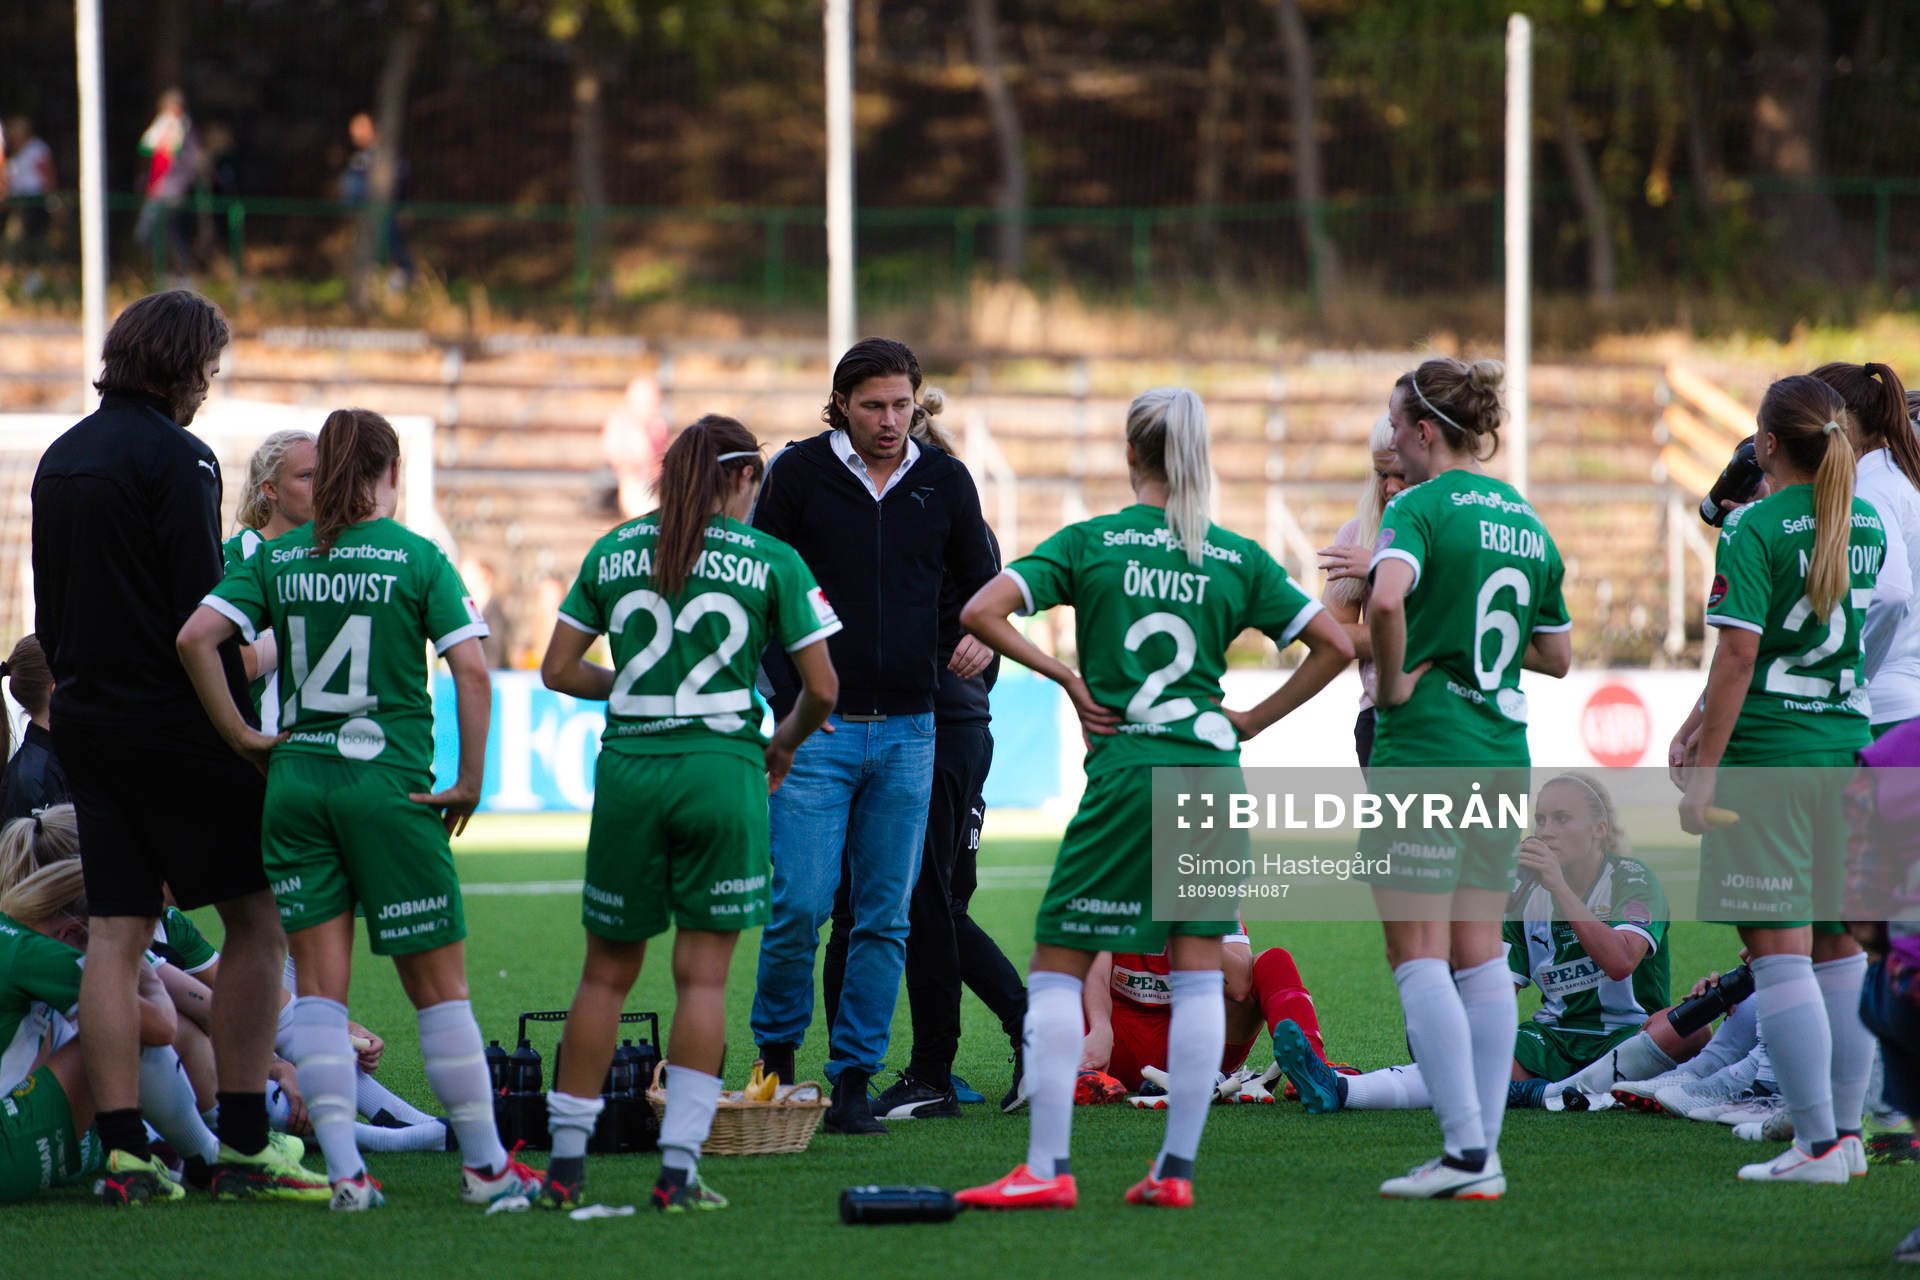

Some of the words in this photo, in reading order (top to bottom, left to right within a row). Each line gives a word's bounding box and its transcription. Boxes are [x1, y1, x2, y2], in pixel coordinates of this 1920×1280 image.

[1782, 515, 1816, 534] Sefi
[1103, 529, 1158, 547] Sefina
[1479, 520, 1545, 562] EKBLOM
[329, 544, 409, 564] pantbank
[598, 548, 771, 592] ABRAMSSON
[276, 572, 398, 604] LUNDQVIST
[1124, 559, 1211, 604] ÖKVIST
[1473, 566, 1531, 691] 6
[608, 588, 752, 717] 22
[283, 614, 379, 726] 14
[1123, 611, 1198, 724] 2
[967, 828, 979, 850] JB
[1387, 841, 1457, 861] JOBMAN
[272, 876, 302, 896] MAN
[1721, 873, 1794, 892] JOBMAN
[378, 895, 448, 920] JOBMAN
[1065, 897, 1142, 916] JOBMAN
[1752, 902, 1778, 912] LINE
[380, 924, 411, 940] SILJA
[412, 921, 436, 935] LINE
[1126, 974, 1170, 993] PEA
